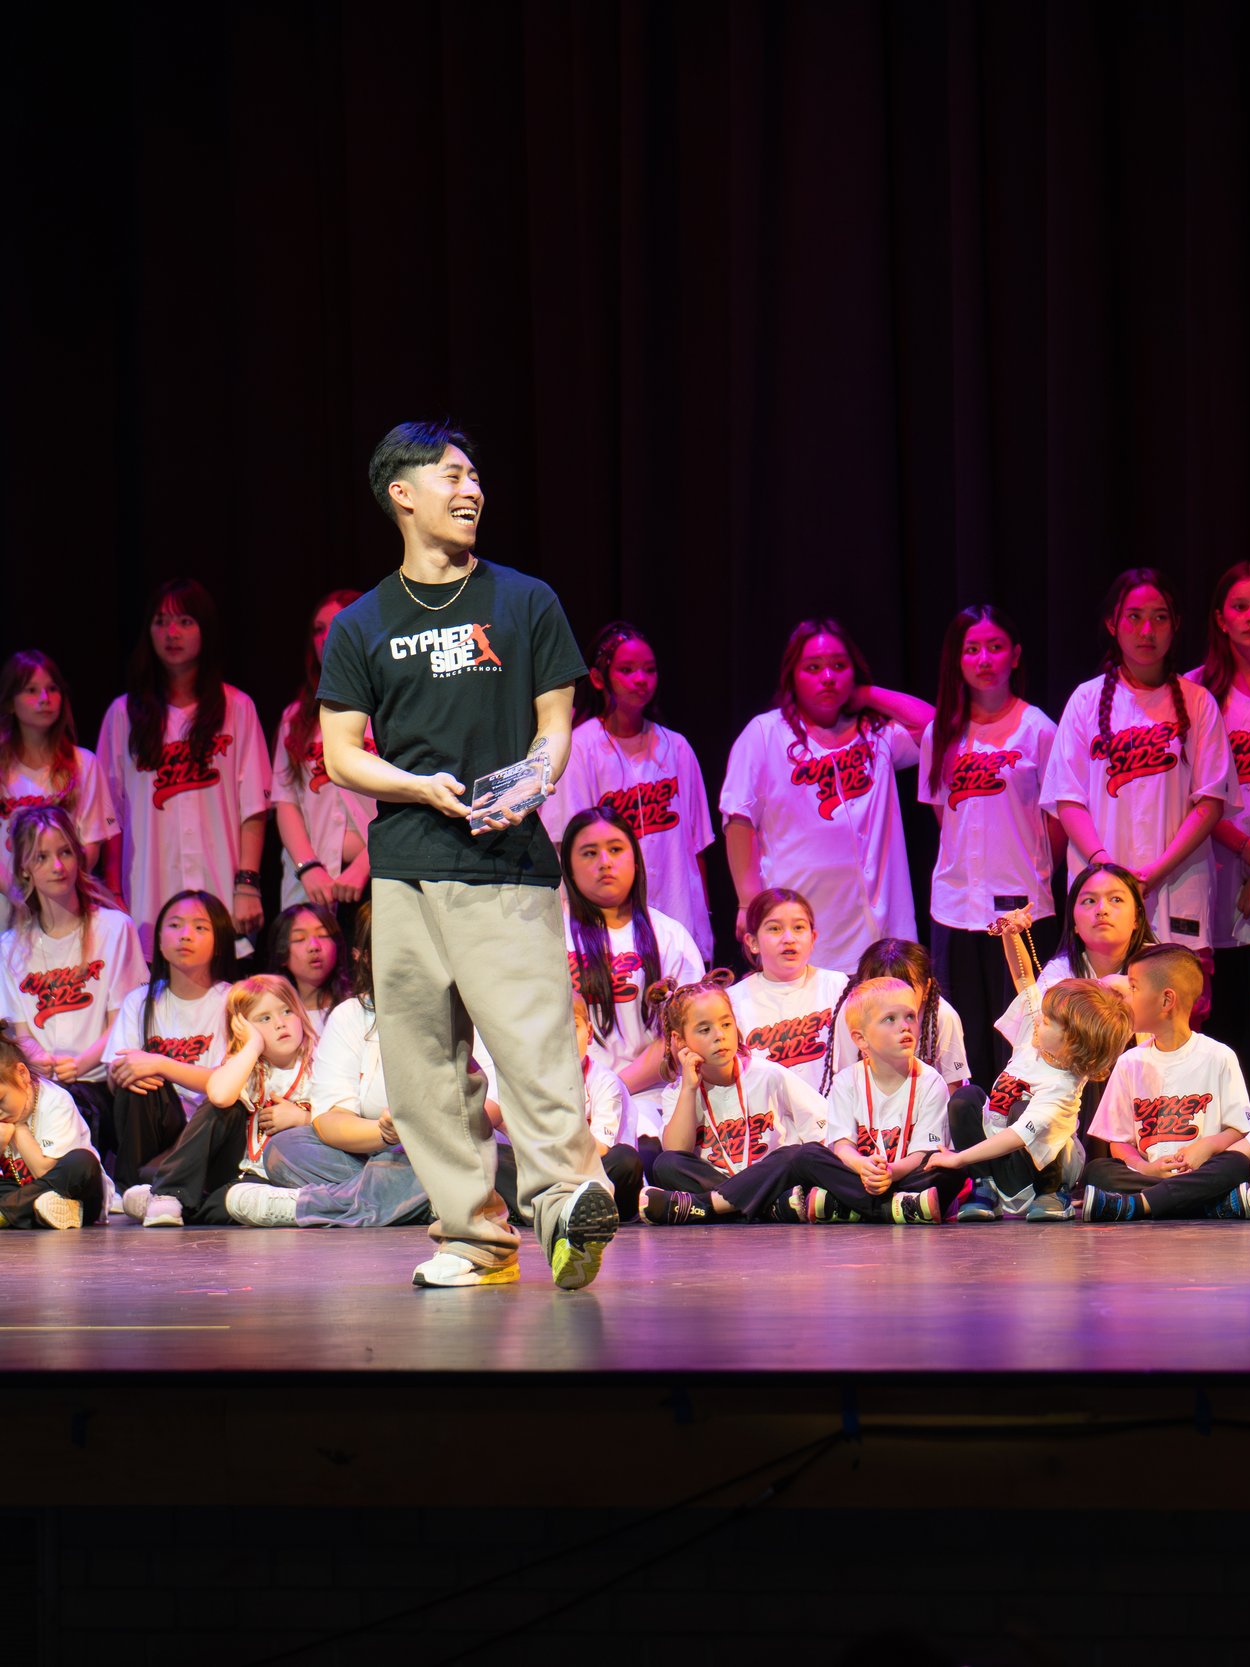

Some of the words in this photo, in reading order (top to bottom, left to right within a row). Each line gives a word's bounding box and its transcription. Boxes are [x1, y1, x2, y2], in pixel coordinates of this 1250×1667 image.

[390, 623, 474, 660] CYPHER
[430, 643, 477, 673] SIDE
[433, 669, 462, 678] DANCE
[791, 741, 875, 785] CYPHER
[953, 751, 1022, 772] YPHER
[1106, 742, 1178, 782] SIDE
[816, 765, 874, 805] SIDE
[947, 769, 1006, 800] SIDE
[622, 800, 679, 832] SIDE
[44, 981, 93, 1014] SIDE
[746, 1007, 833, 1050] CYPHER
[766, 1031, 827, 1064] SIDE
[1133, 1093, 1214, 1122] CYPHER
[1137, 1115, 1199, 1145] SIDE
